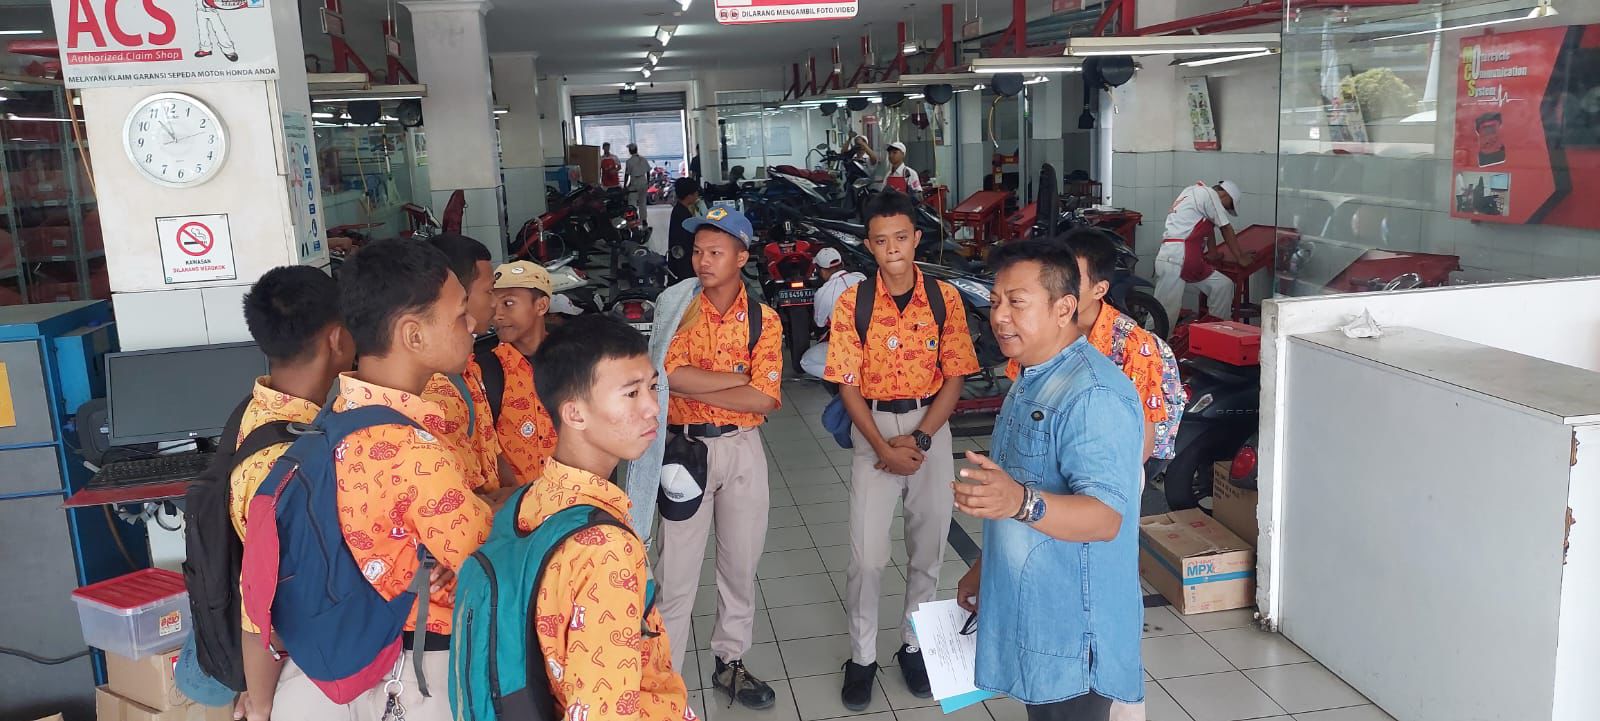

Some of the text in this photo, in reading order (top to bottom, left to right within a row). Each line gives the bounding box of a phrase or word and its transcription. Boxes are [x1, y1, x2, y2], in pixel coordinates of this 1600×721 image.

[742, 6, 855, 18] DILARANG MENGAMBIL FOTO/VIDEO
[67, 0, 176, 48] ACS
[71, 50, 179, 63] Authorized Claim Shop
[68, 75, 107, 83] MELAYANI
[150, 108, 158, 119] 11
[139, 121, 150, 132] 10
[199, 118, 206, 129] 2
[138, 137, 144, 148] 9
[208, 134, 215, 144] 3
[145, 153, 152, 163] 8
[207, 151, 213, 160] 4
[162, 164, 168, 175] 7
[178, 168, 184, 178] 6
[195, 163, 202, 173] 5
[1187, 563, 1213, 577] MPX
